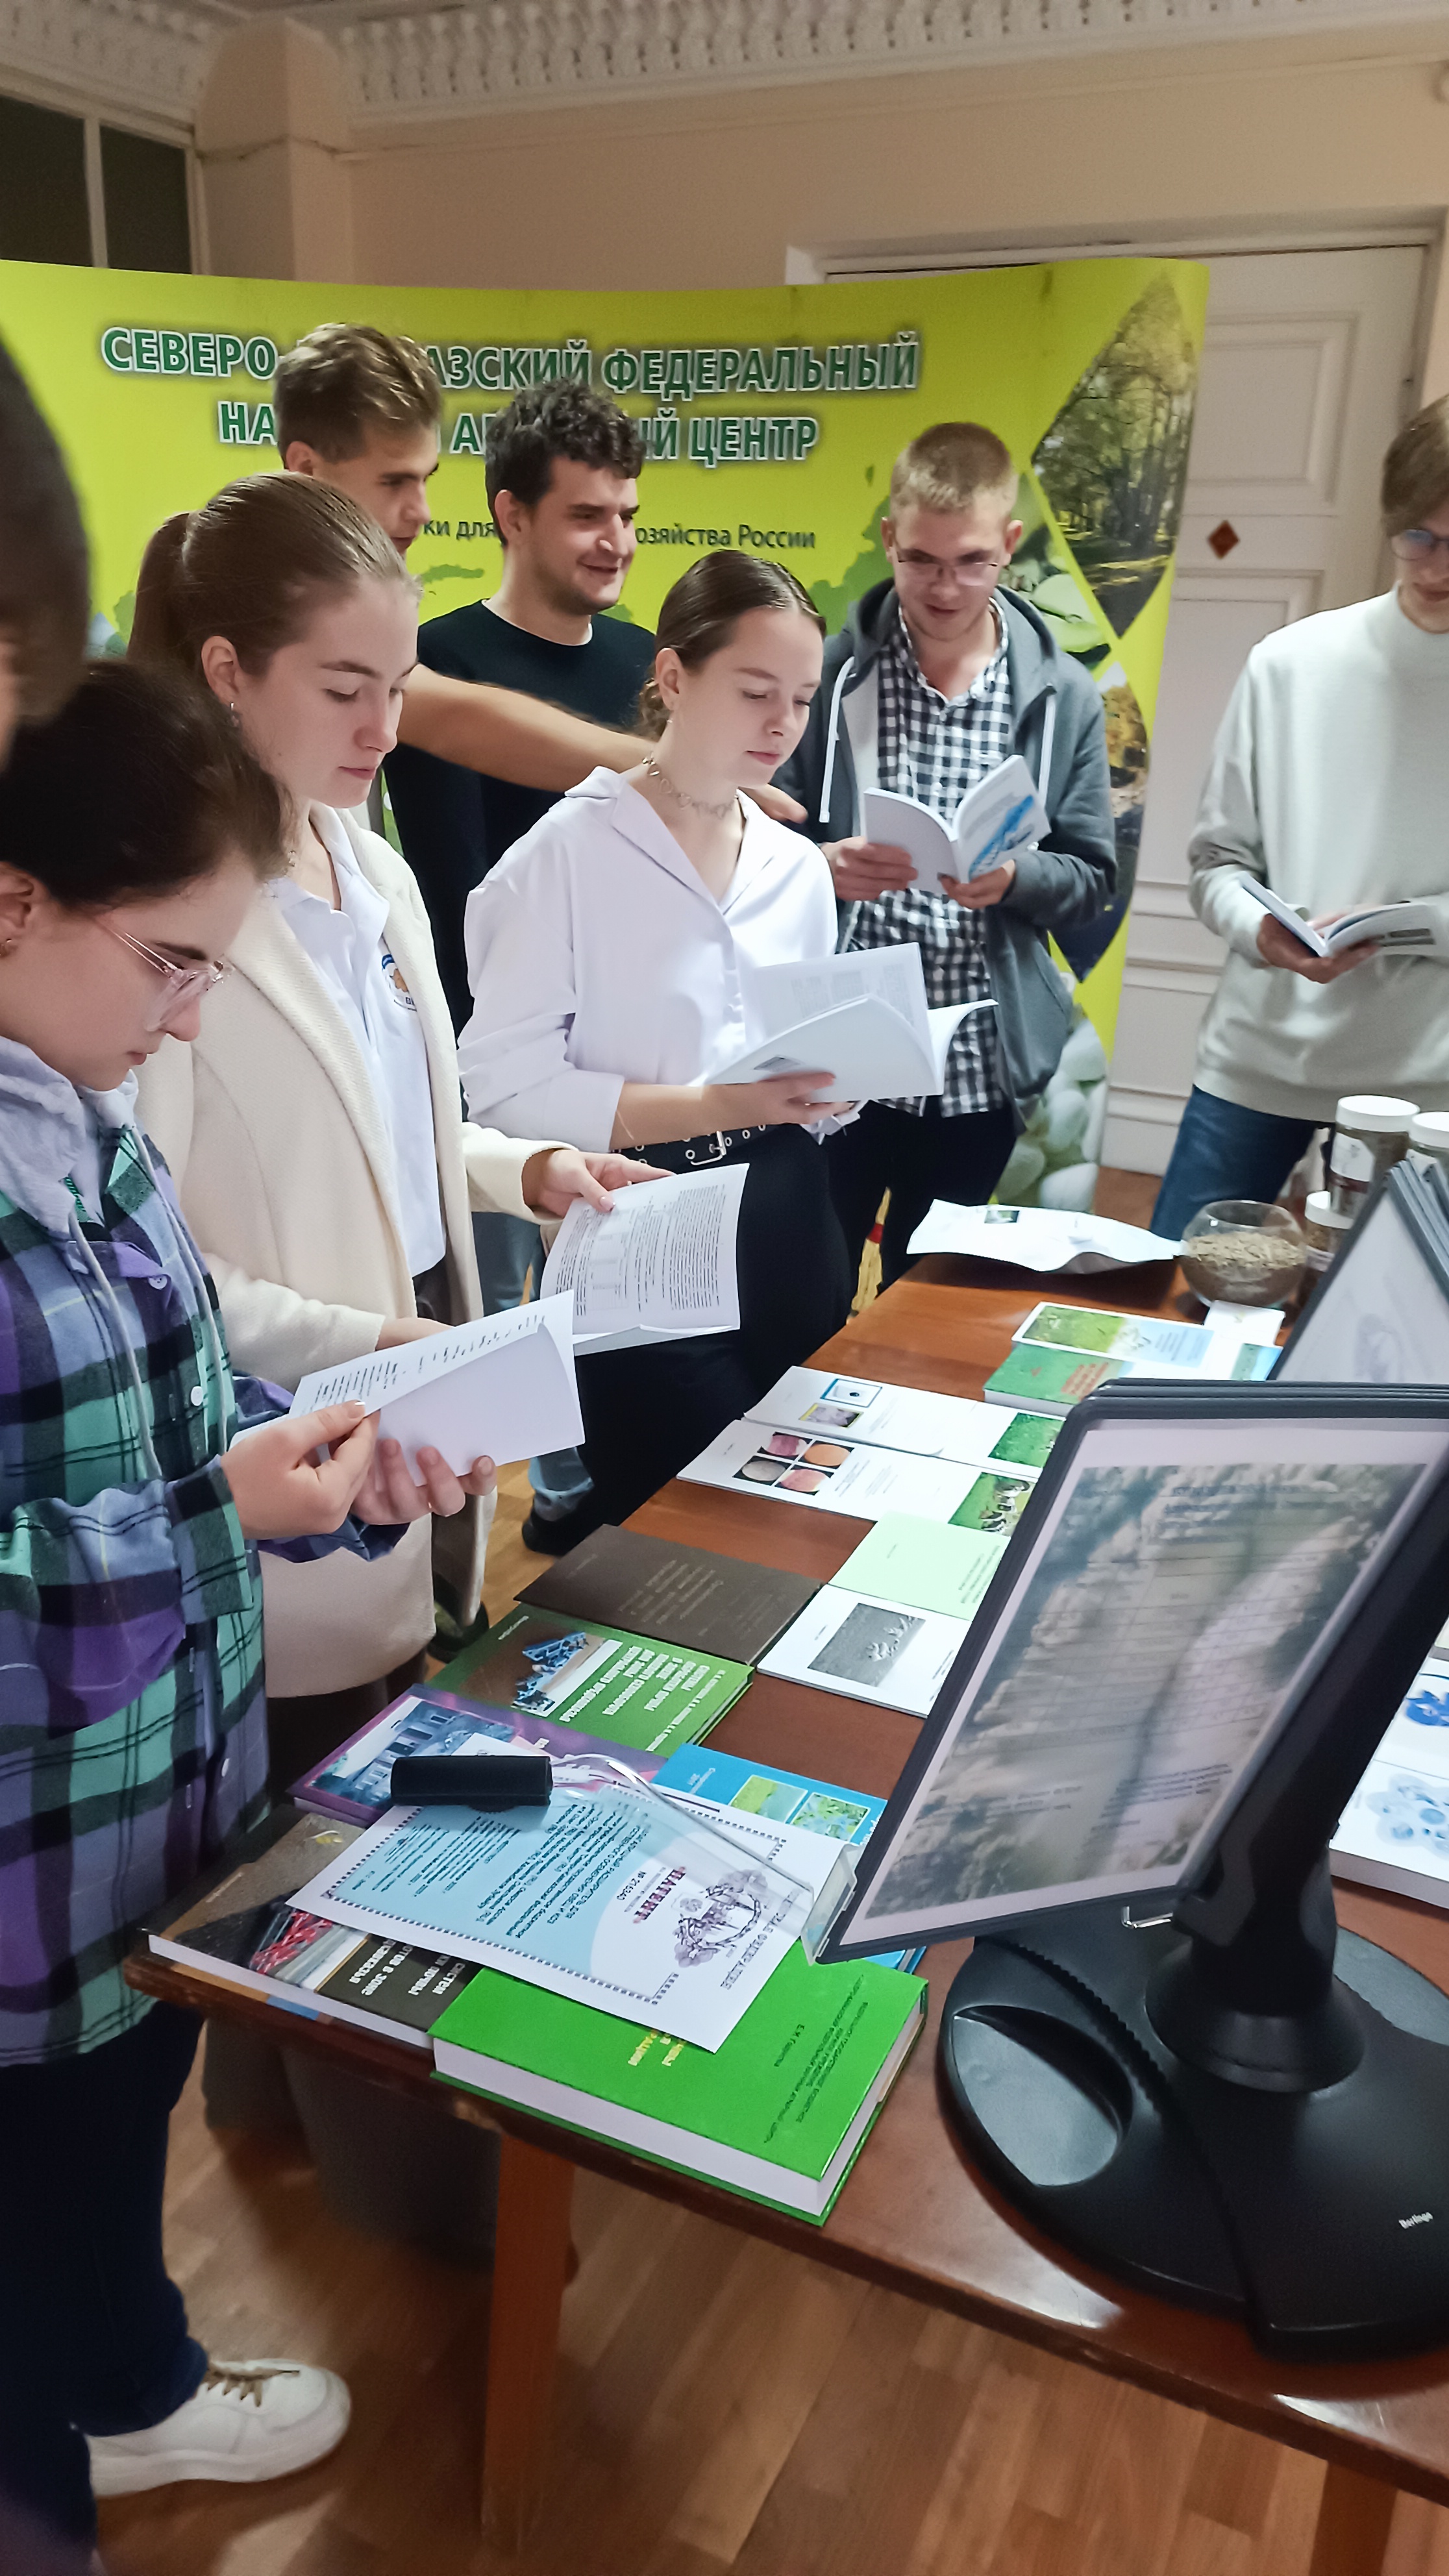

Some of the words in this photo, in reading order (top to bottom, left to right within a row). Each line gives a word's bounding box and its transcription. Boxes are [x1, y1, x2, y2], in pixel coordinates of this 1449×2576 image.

[601, 331, 919, 401] ФЕДЕРАЛЬНЫЙ
[688, 417, 820, 469] ЦЕНТР
[634, 522, 732, 547] озяйства
[738, 523, 817, 549] России
[632, 1868, 686, 1921] ПАТЕНТ
[347, 1938, 397, 1984] дкавказья
